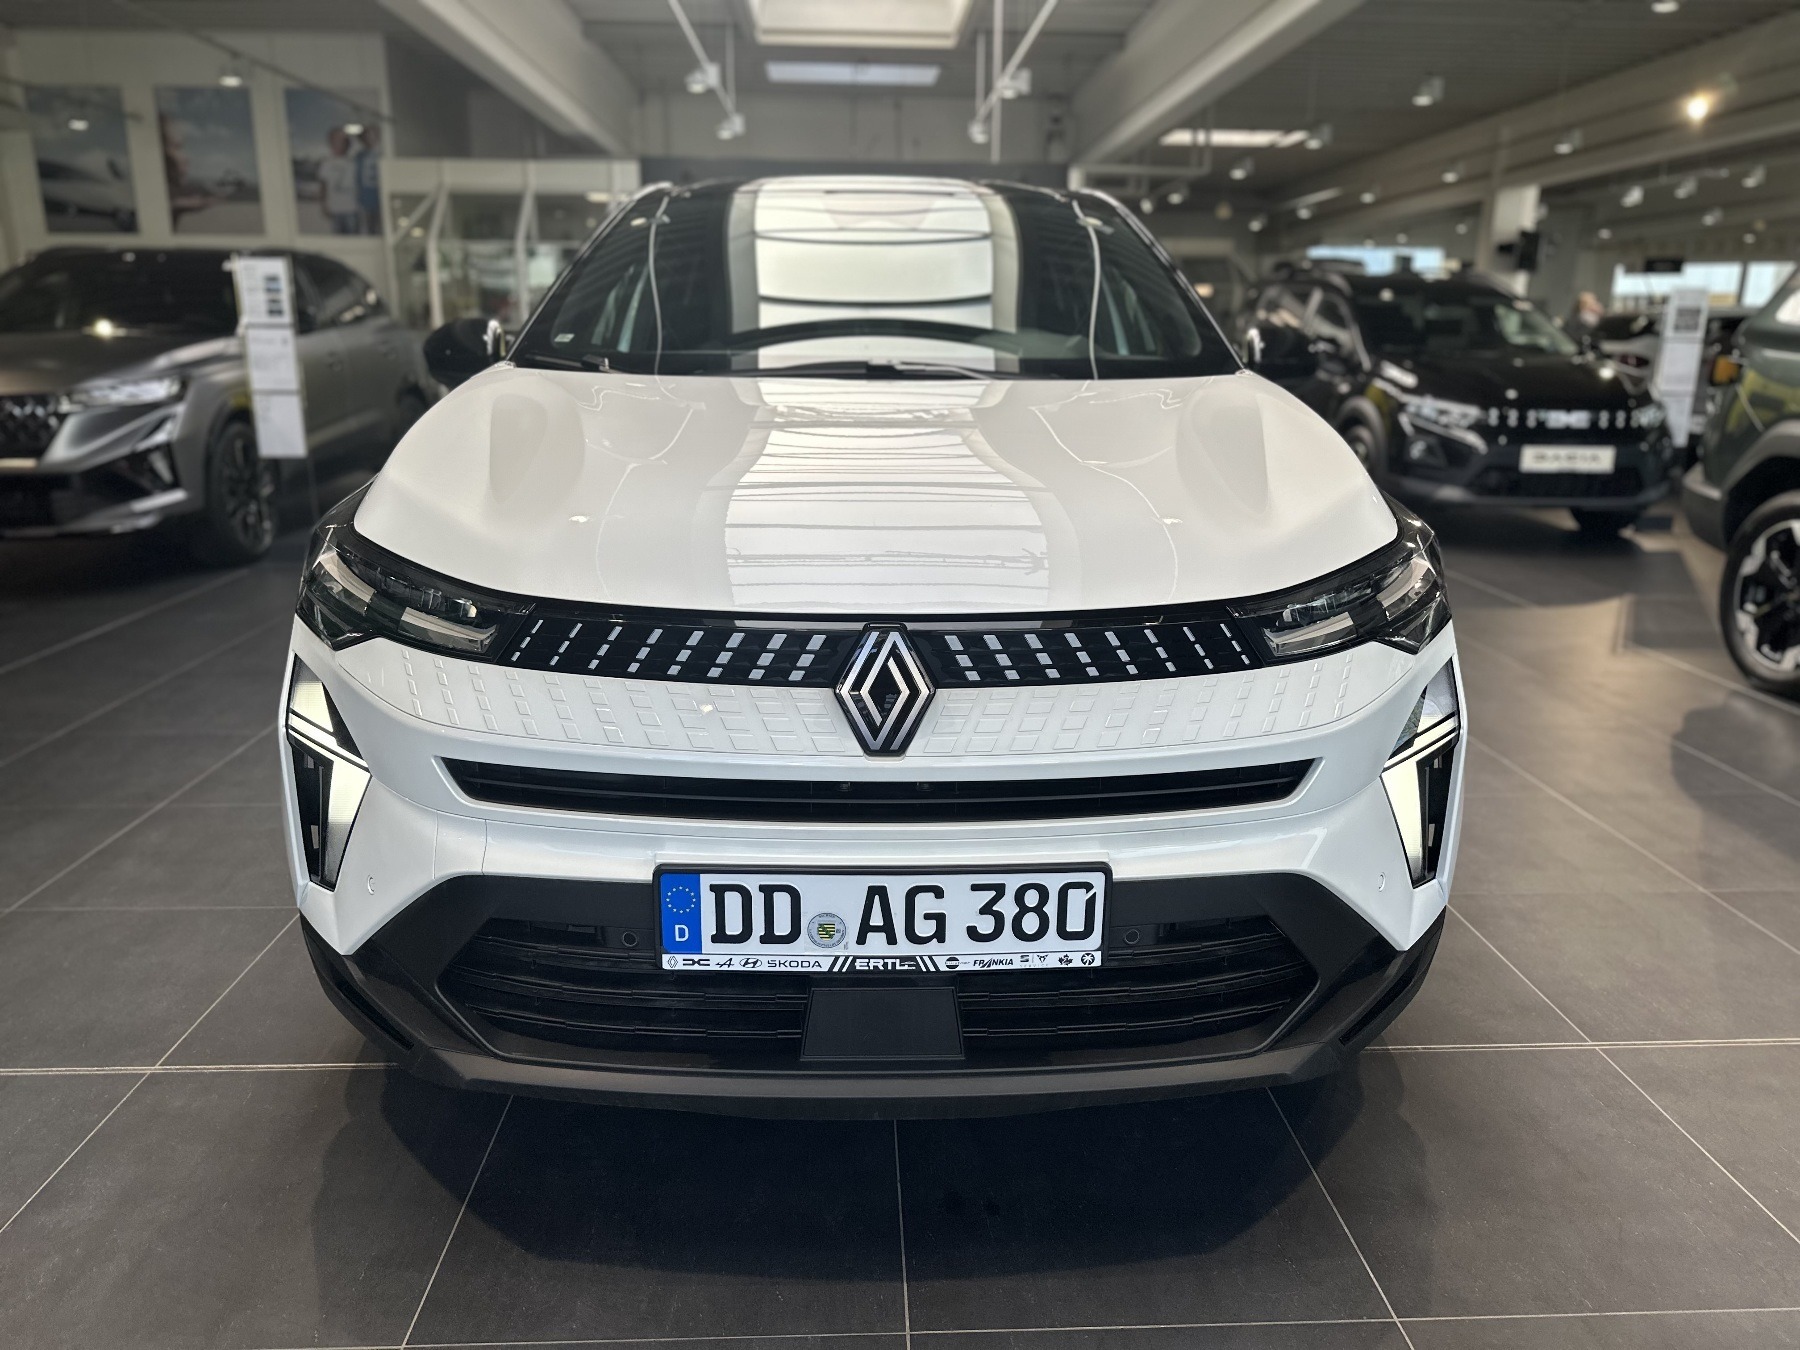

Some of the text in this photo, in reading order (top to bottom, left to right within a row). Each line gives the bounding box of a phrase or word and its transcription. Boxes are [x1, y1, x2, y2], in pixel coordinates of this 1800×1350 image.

[709, 881, 1097, 946] DD AG 380
[674, 924, 689, 942] D
[973, 957, 1014, 969] FRANKIA
